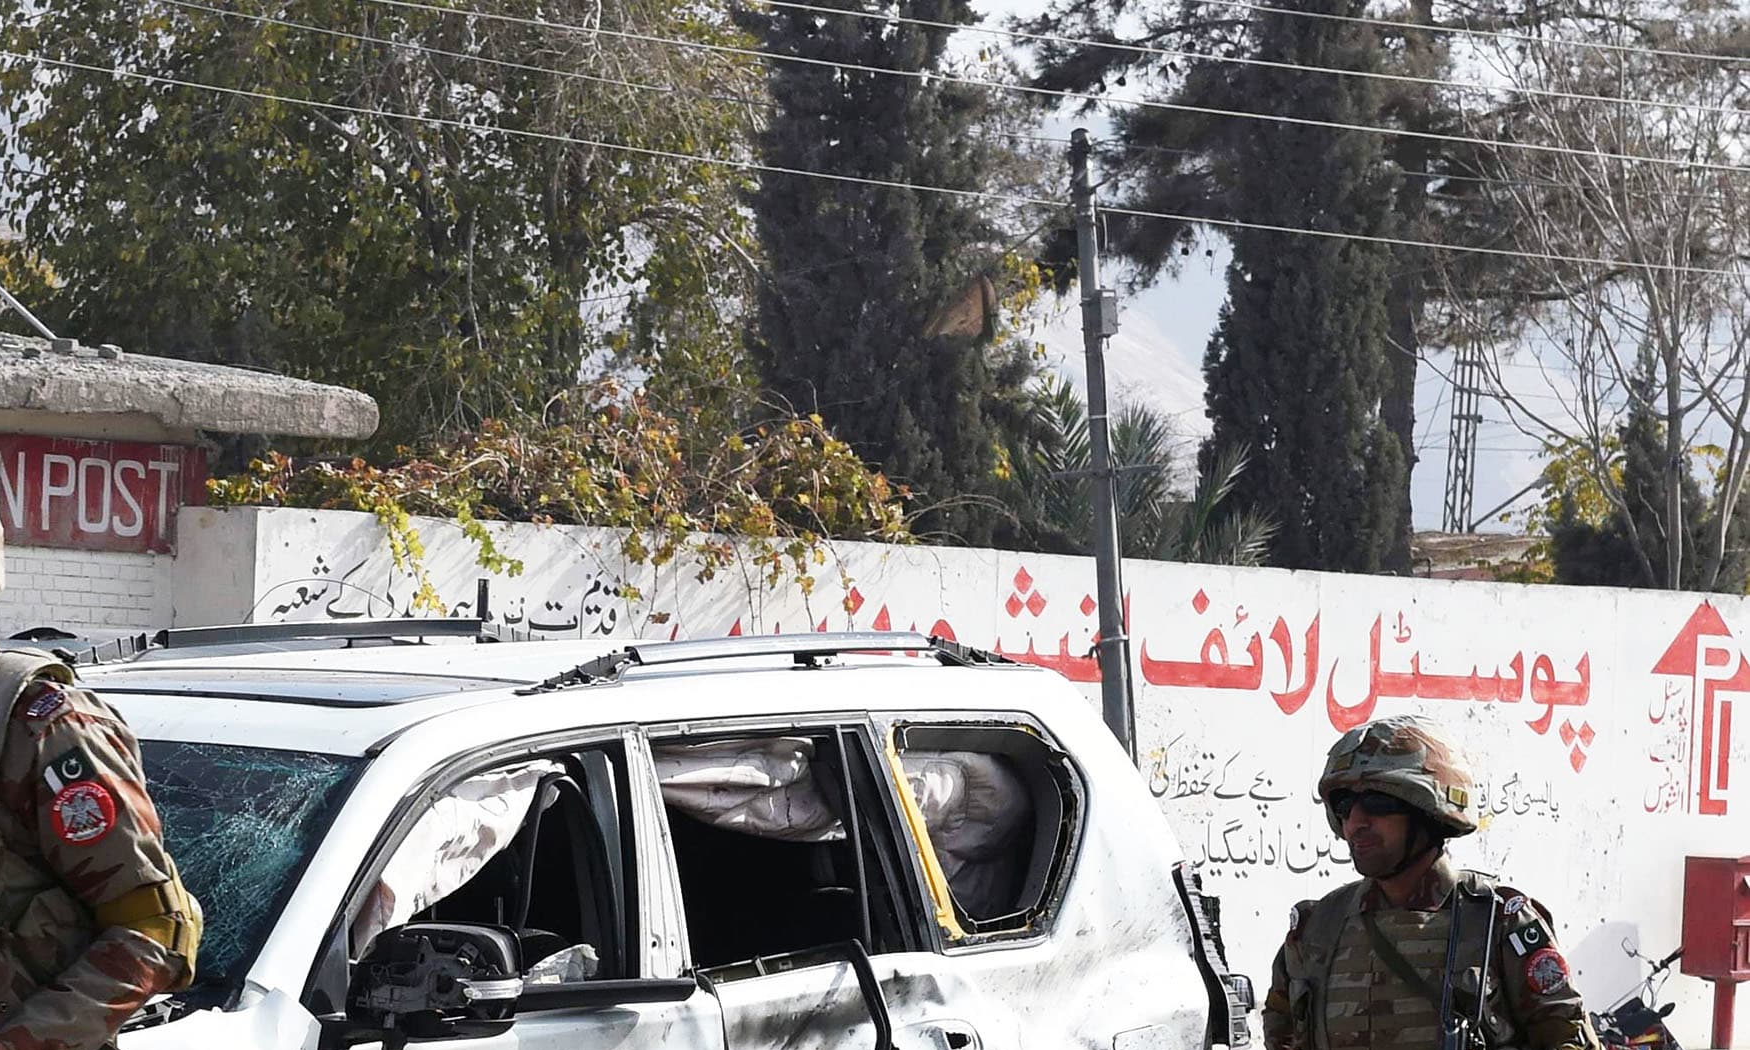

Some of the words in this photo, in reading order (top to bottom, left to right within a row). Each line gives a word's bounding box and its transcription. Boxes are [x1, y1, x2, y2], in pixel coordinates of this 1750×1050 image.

[41, 454, 179, 540] POST
[1139, 587, 1321, 716] لائف
[1326, 610, 1596, 774] پوسٹل
